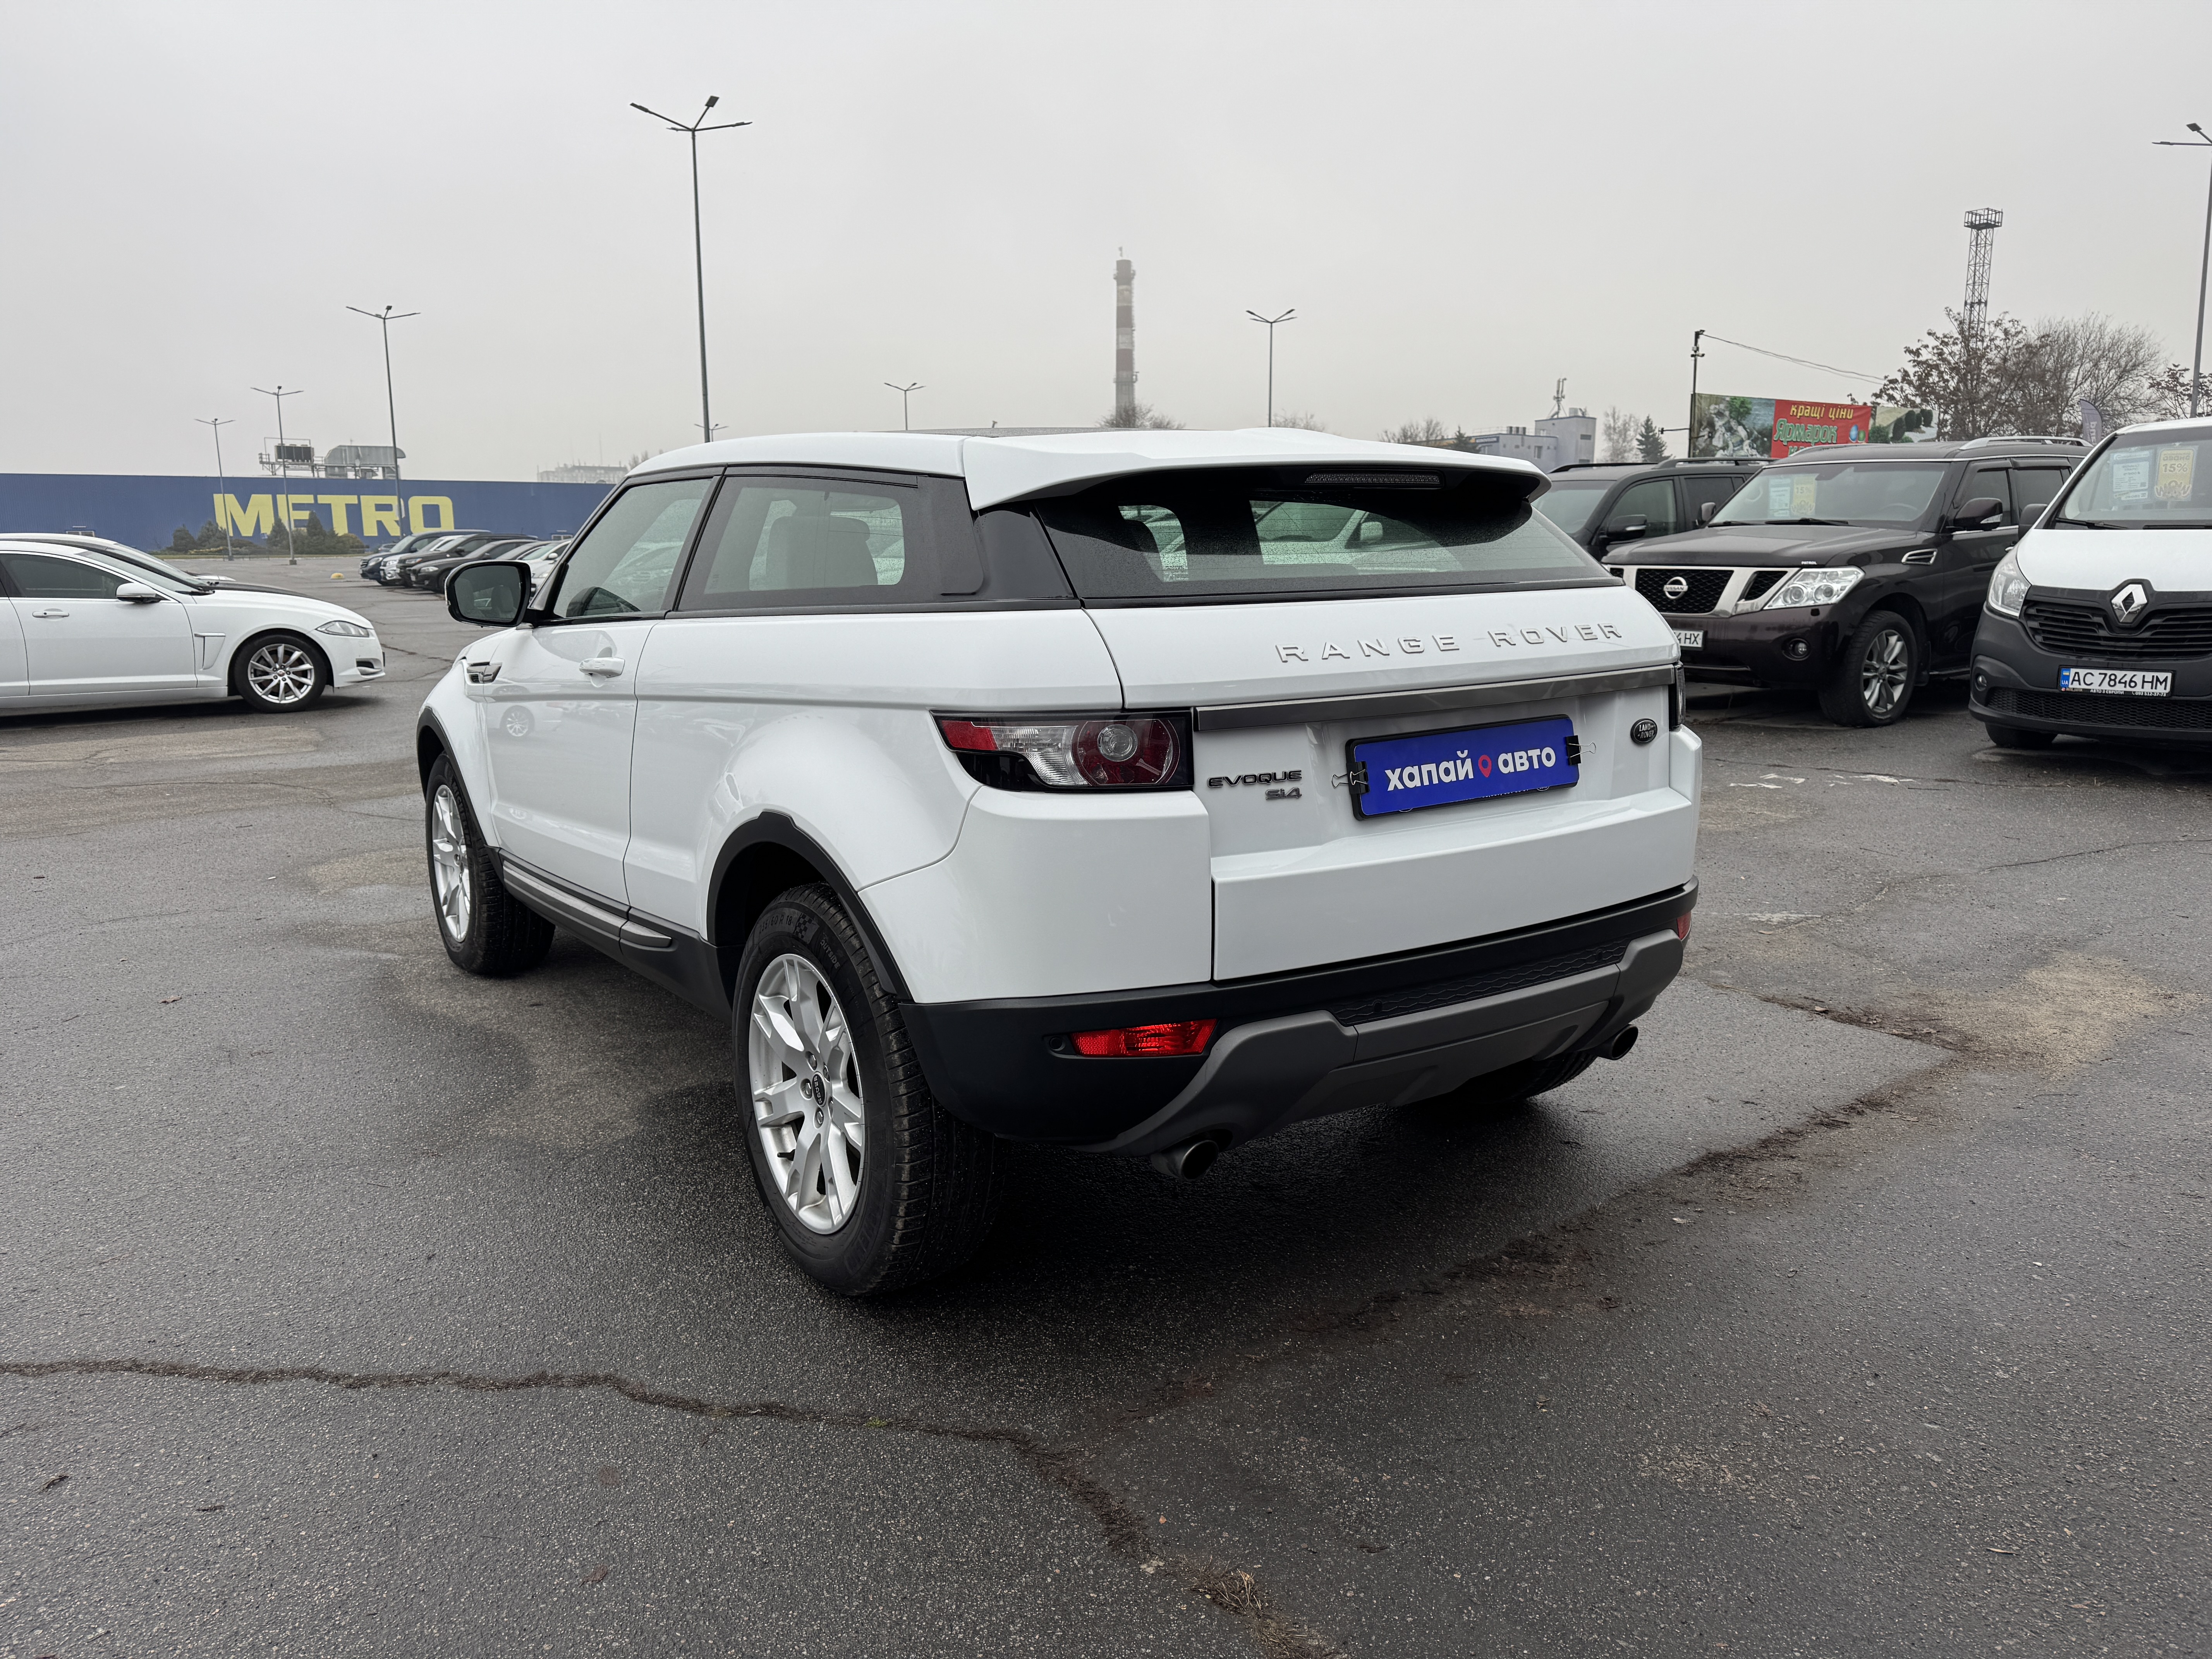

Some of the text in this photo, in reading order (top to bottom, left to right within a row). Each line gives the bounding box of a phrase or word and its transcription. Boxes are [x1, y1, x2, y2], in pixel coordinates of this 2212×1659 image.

[1790, 404, 1853, 421] кращі ціни
[1773, 418, 1838, 446] Ярмарок
[2163, 463, 2188, 472] 15%
[213, 493, 455, 536] METRO
[1275, 623, 1622, 663] RANGE ROVER
[1684, 633, 1700, 645] HX
[2070, 672, 2168, 690] AC 7846 HM
[1639, 723, 1651, 732] LAND
[1640, 730, 1654, 738] ROVER
[1385, 747, 1556, 791] хапай авто
[1207, 769, 1302, 788] EVOQUE
[1265, 787, 1302, 800] Si4
[785, 915, 793, 925] 18
[820, 939, 840, 969] OUTSIDE
